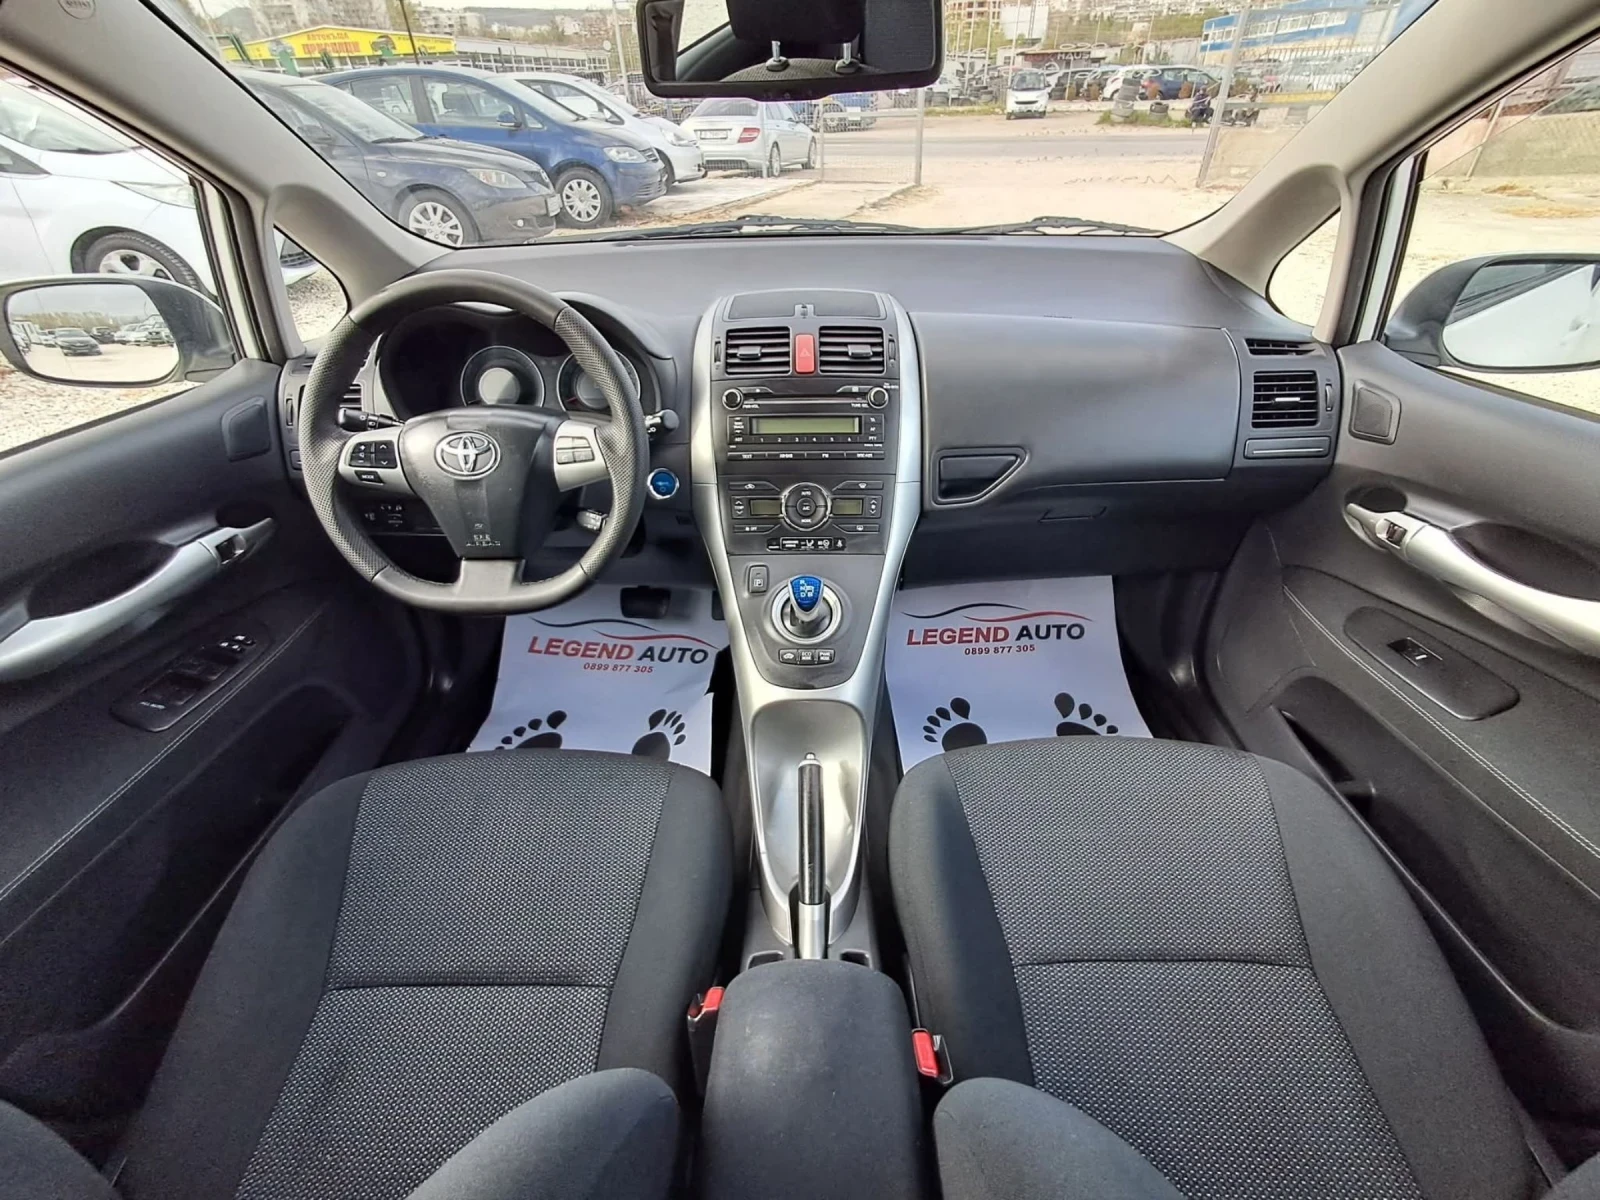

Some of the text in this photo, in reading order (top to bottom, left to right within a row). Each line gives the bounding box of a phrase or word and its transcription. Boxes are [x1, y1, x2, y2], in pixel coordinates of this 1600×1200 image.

[1057, 51, 1090, 61] HAUS
[906, 623, 1085, 646] LEGEND AUTO
[528, 636, 709, 664] LEGEND AUTO
[964, 644, 1036, 656] 0899 877 305
[583, 662, 654, 674] 0899 877 305
